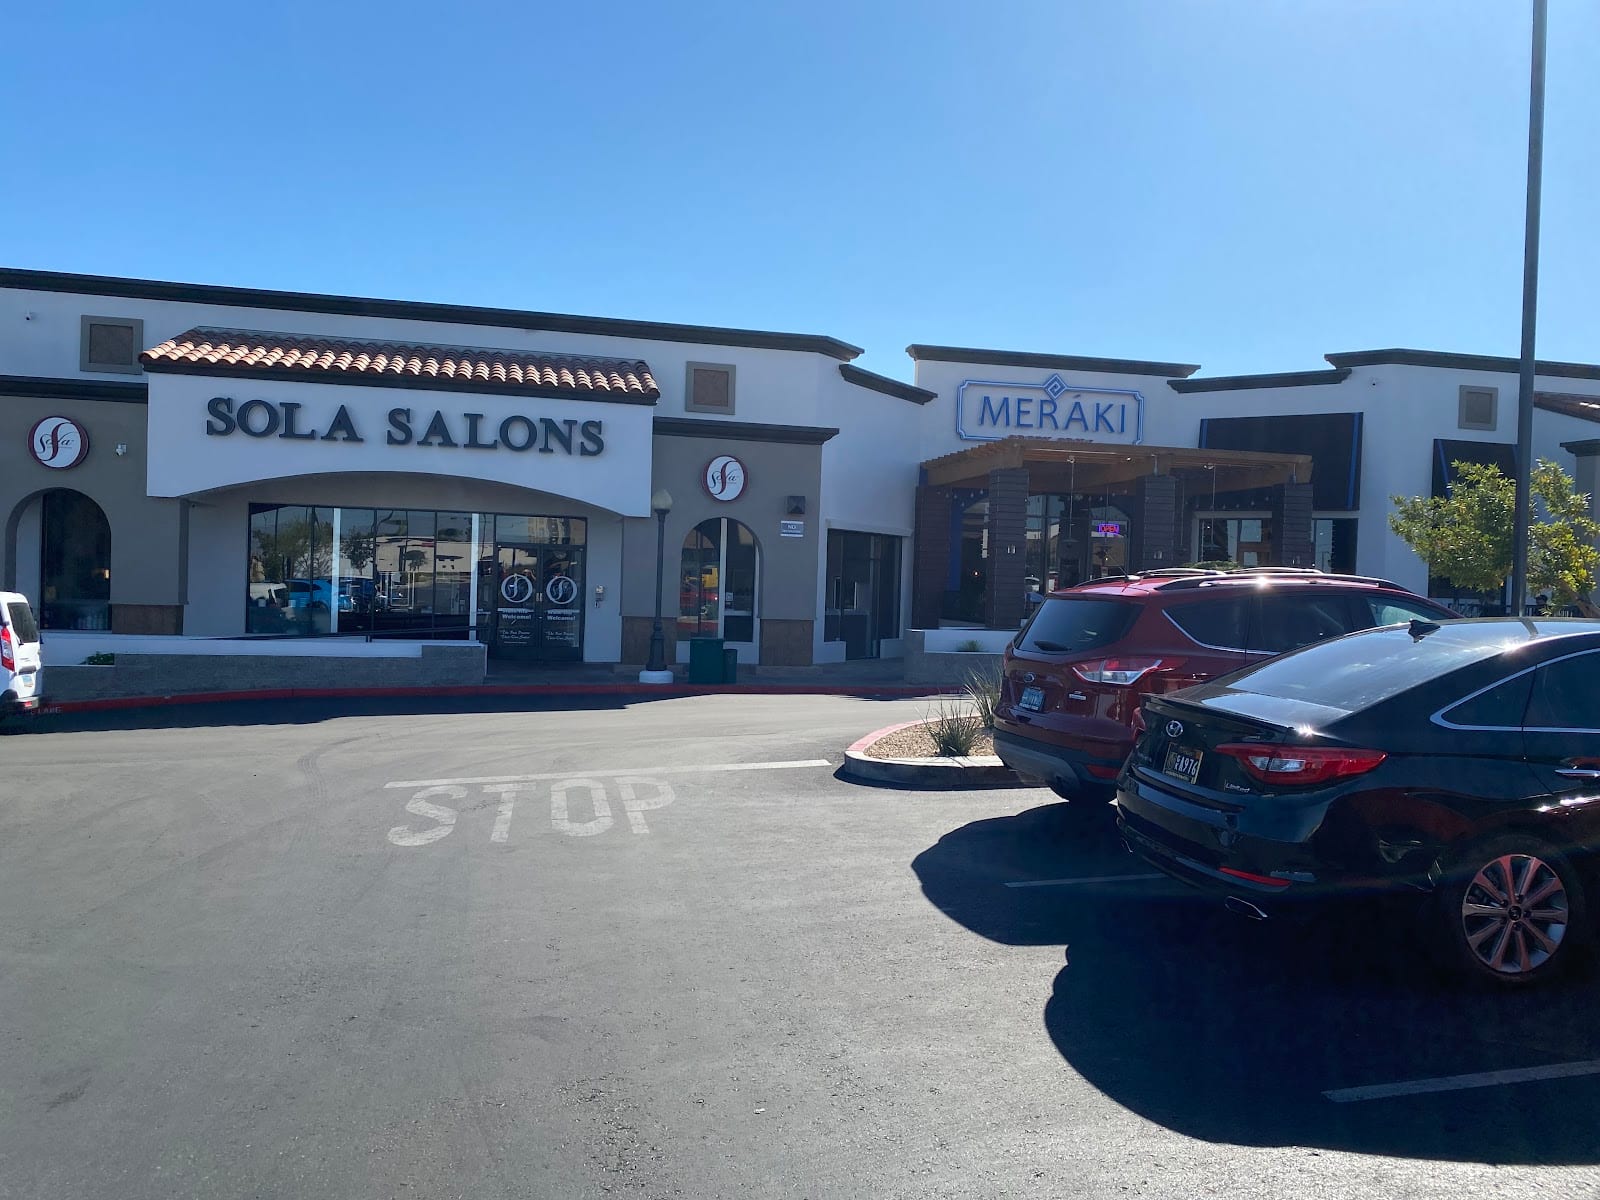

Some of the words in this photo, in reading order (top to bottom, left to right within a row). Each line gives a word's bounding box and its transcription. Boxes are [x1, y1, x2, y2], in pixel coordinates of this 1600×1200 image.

[206, 397, 364, 442] SOLA
[386, 407, 605, 457] SALONS
[978, 395, 1126, 433] MERÁKI
[1100, 525, 1119, 533] OPEN
[388, 776, 675, 846] STOP
